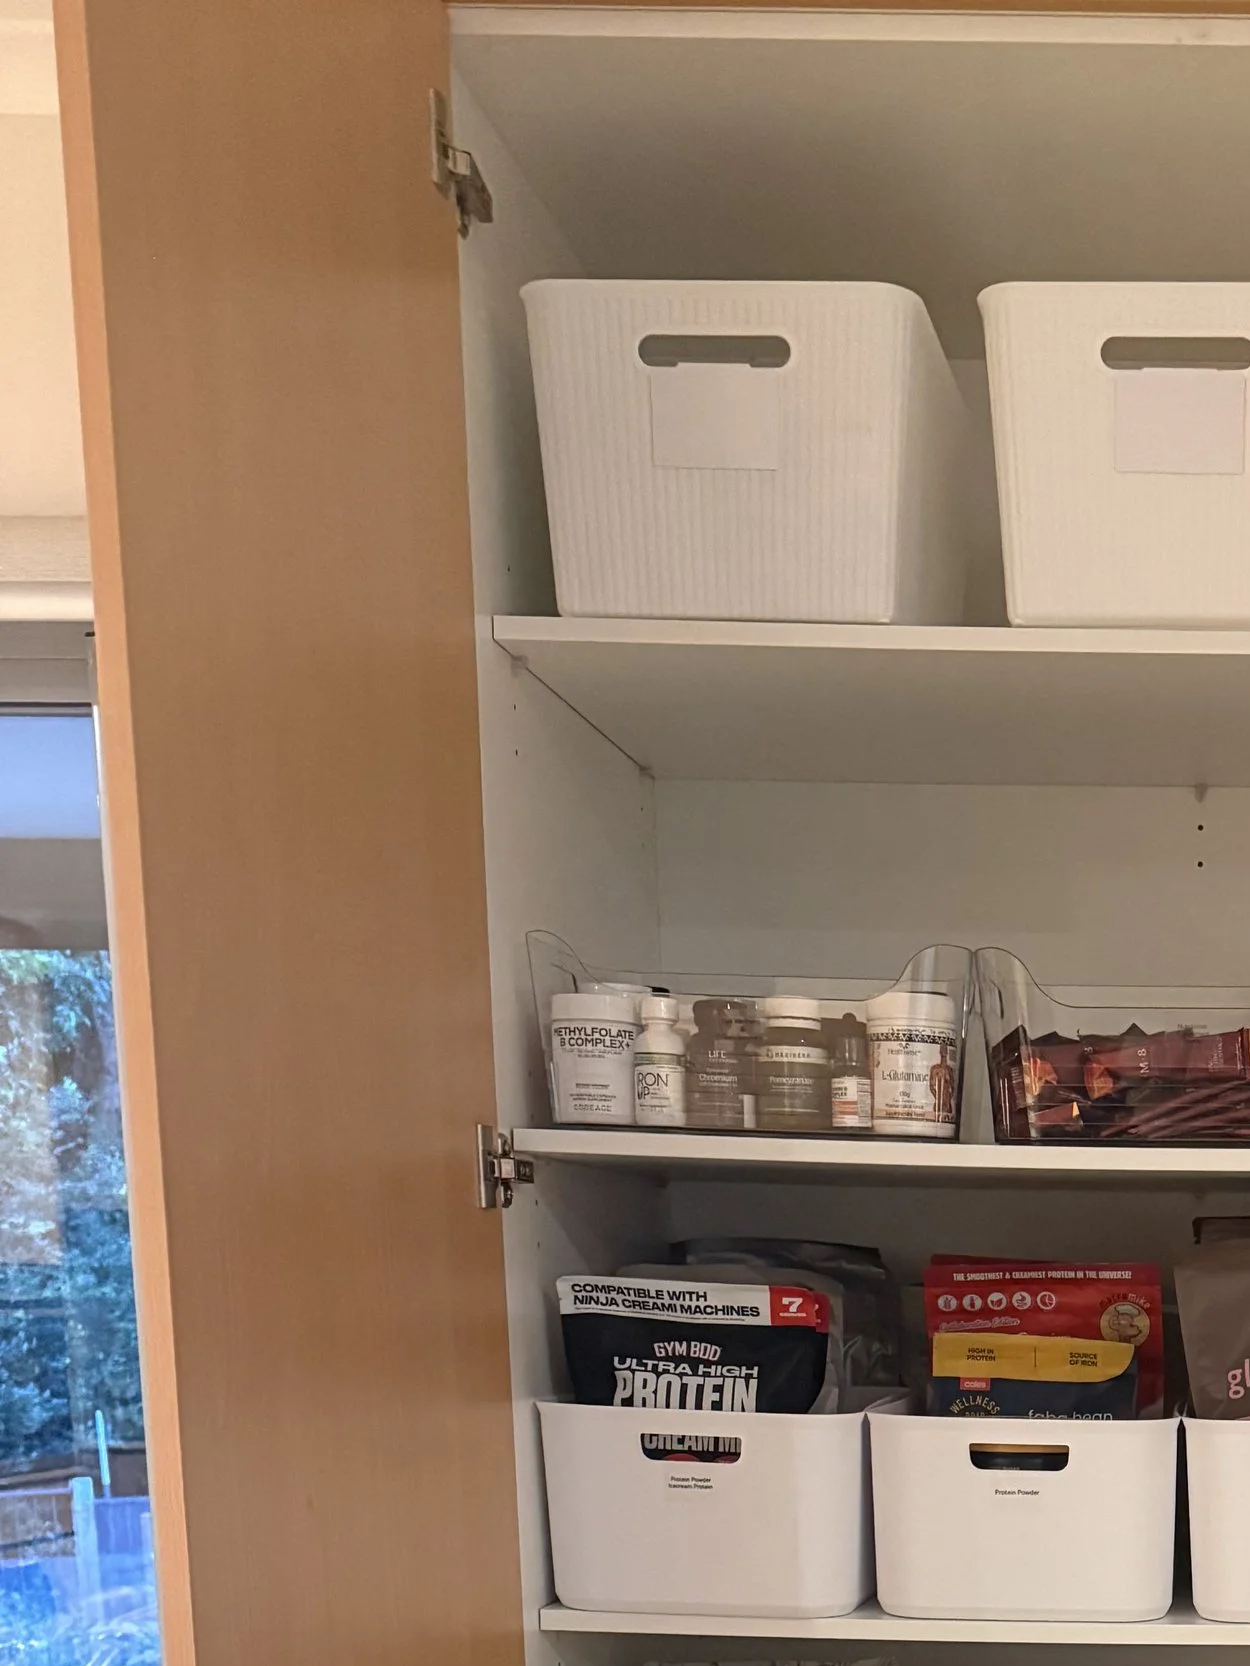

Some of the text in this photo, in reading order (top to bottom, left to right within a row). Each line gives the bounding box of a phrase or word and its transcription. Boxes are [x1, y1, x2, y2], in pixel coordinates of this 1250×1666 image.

[967, 1272, 1002, 1280] SMOOTHEST
[571, 1283, 708, 1302] COMPATIBLE WITH
[574, 1295, 760, 1317] NINJA CREAMI MACHINES
[782, 1297, 803, 1313] 7
[653, 1341, 686, 1357] GYM
[1069, 1352, 1097, 1360] SOURCE
[613, 1356, 759, 1378] ULTRA HIGH
[1081, 1359, 1098, 1367] IRON
[950, 1395, 1000, 1415] WELLNESS
